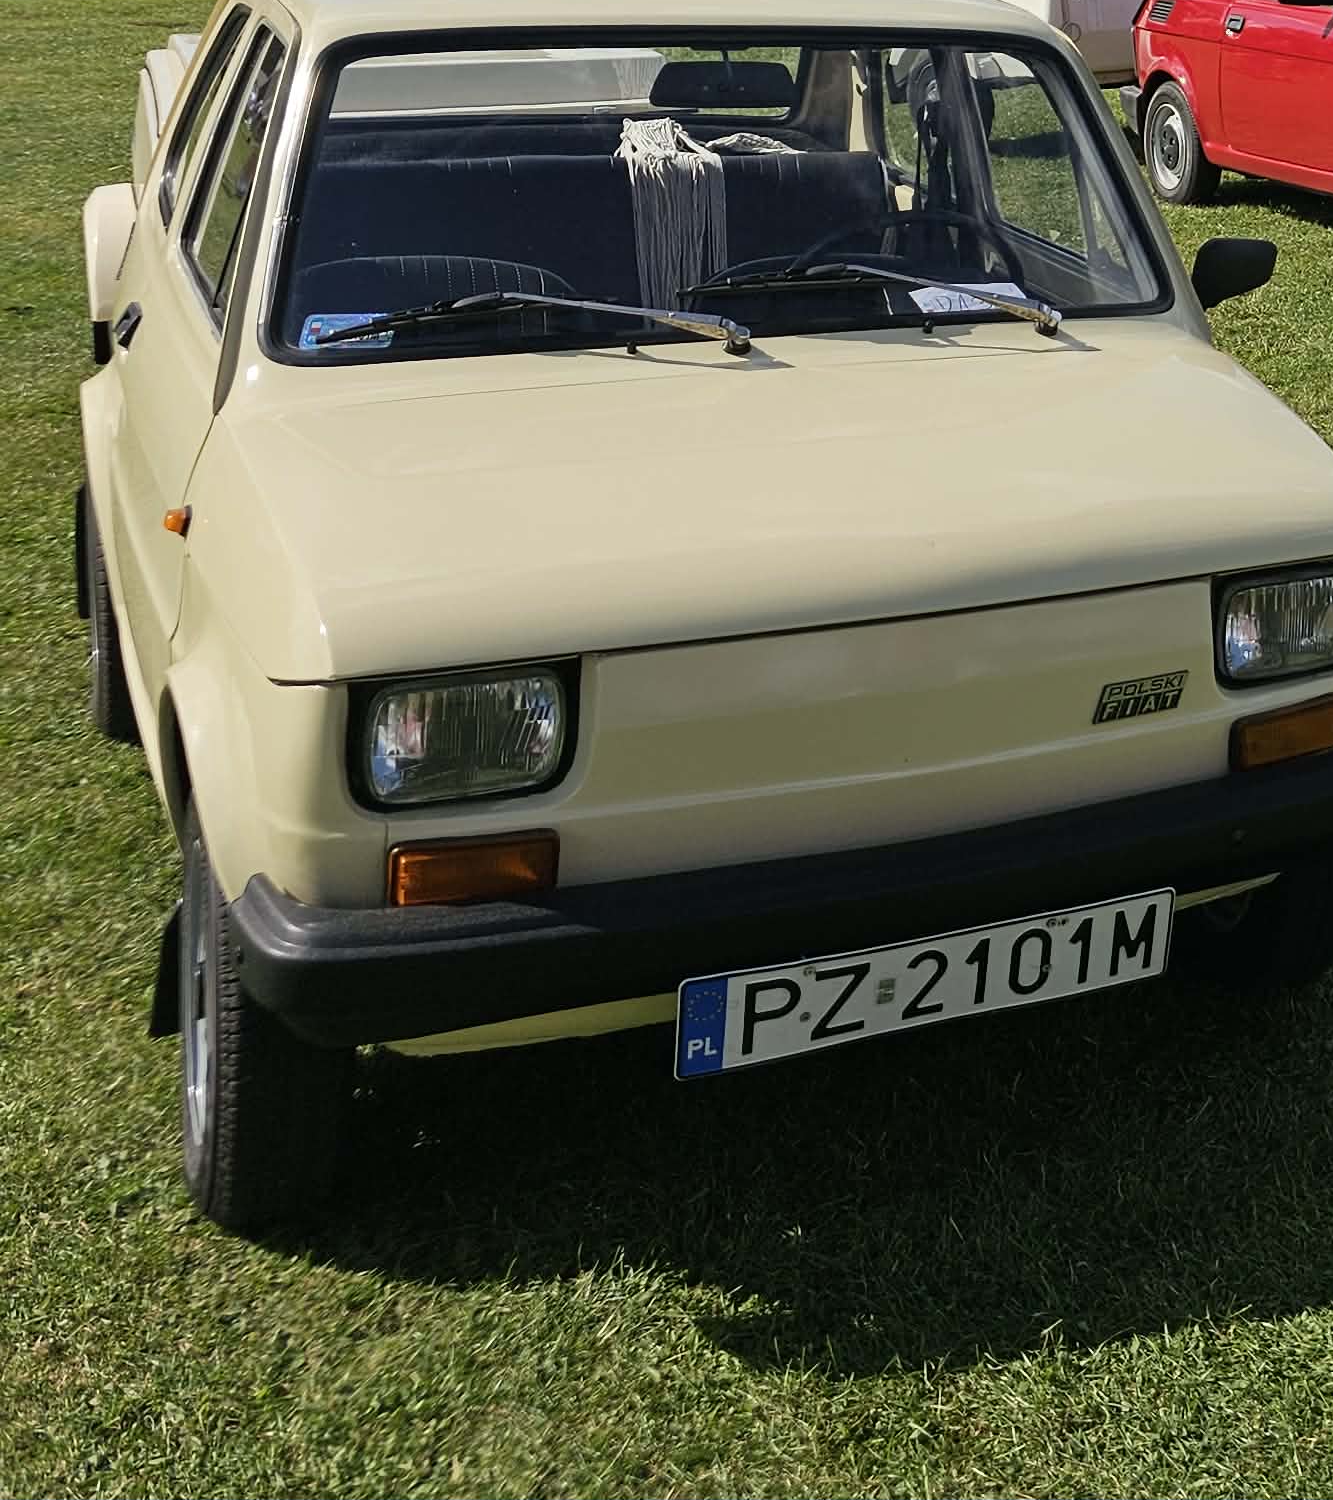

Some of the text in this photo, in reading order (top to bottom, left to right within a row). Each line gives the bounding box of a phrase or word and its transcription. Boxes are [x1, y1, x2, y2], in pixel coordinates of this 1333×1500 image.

[1107, 674, 1185, 700] POLSKI
[1101, 690, 1180, 721] FIAT
[686, 903, 1158, 1061] PL PZ 2101M
